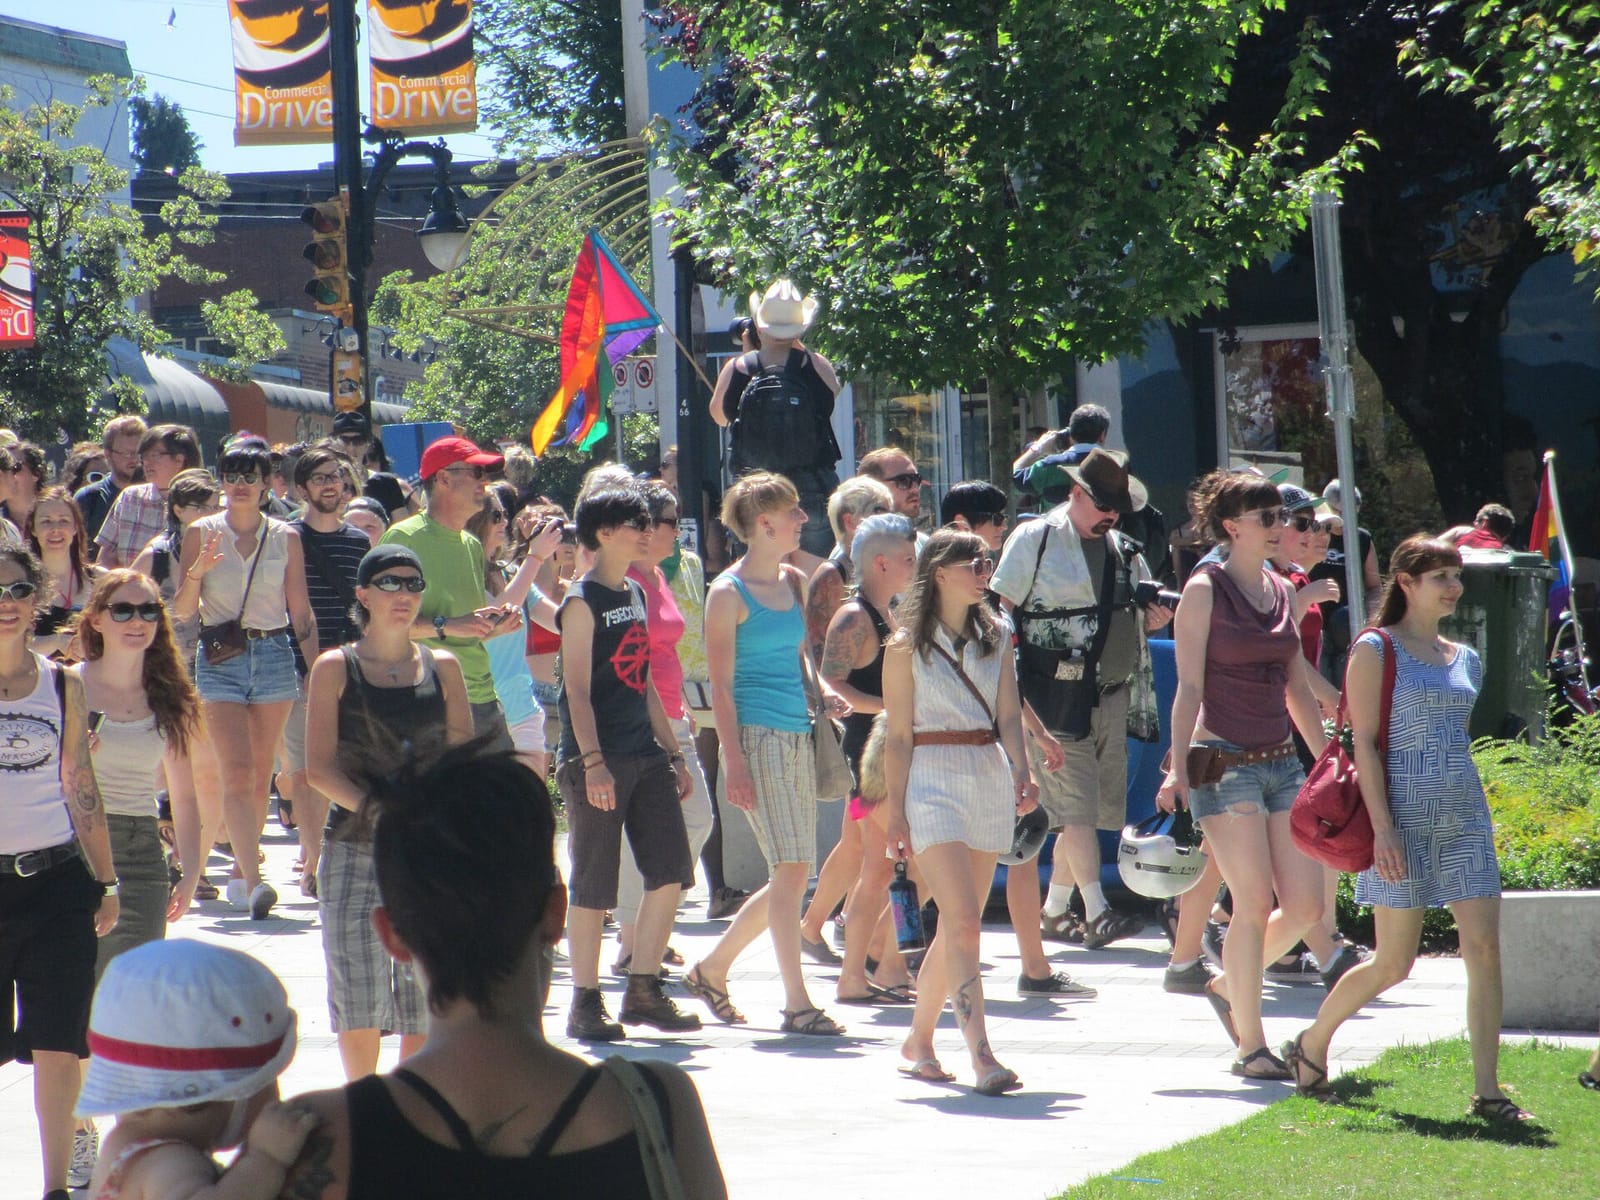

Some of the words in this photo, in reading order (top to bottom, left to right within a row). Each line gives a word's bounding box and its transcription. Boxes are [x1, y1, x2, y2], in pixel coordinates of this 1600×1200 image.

[264, 83, 330, 99] Commercia
[399, 71, 470, 89] Commercial
[242, 91, 333, 128] Drive
[376, 81, 473, 119] Drive
